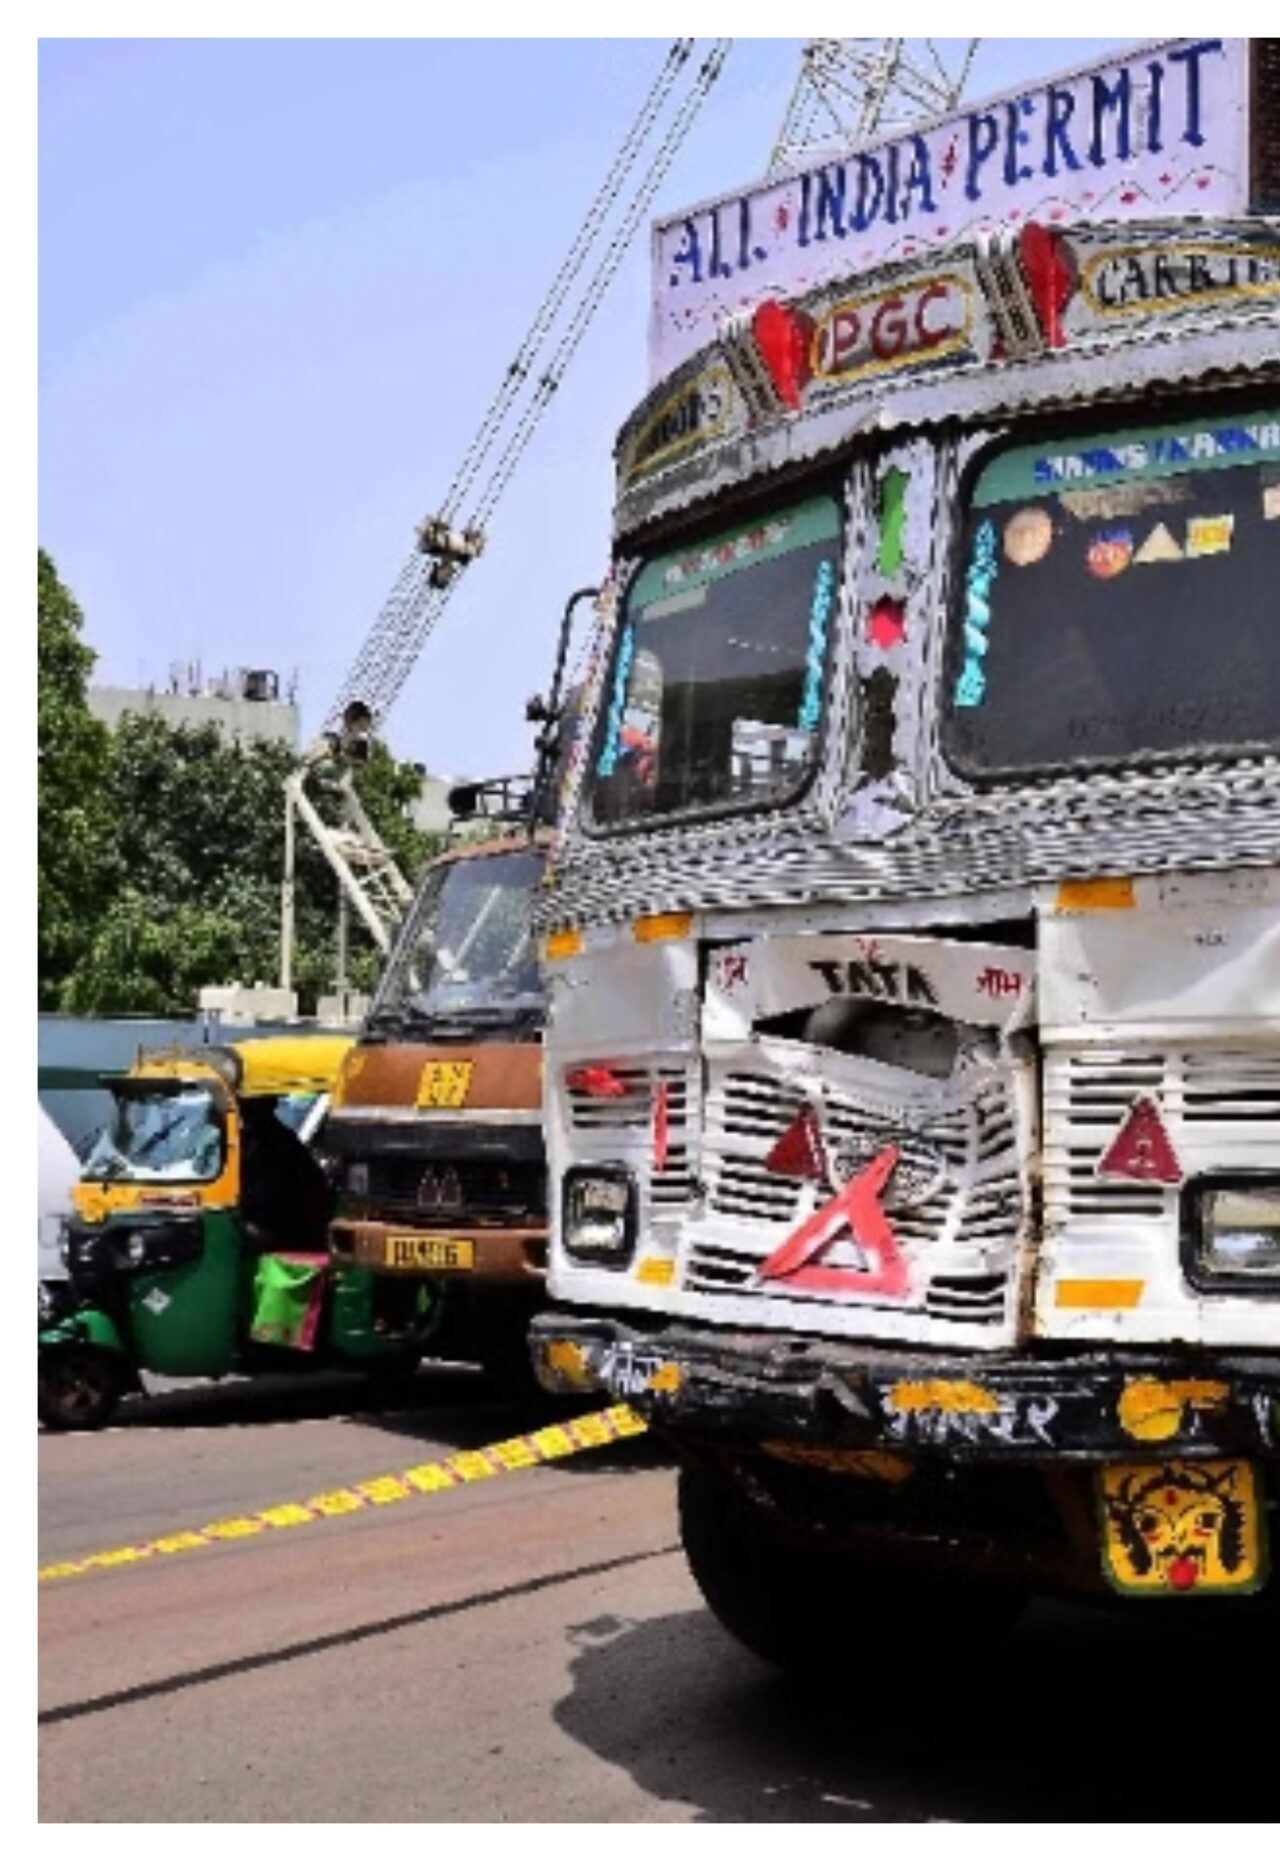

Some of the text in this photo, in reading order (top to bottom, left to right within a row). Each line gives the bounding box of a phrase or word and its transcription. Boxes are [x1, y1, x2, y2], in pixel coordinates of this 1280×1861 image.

[796, 132, 938, 248] INDIA
[964, 37, 1223, 201] PERMIT
[822, 284, 963, 374] PGC
[808, 960, 940, 1004] TATA
